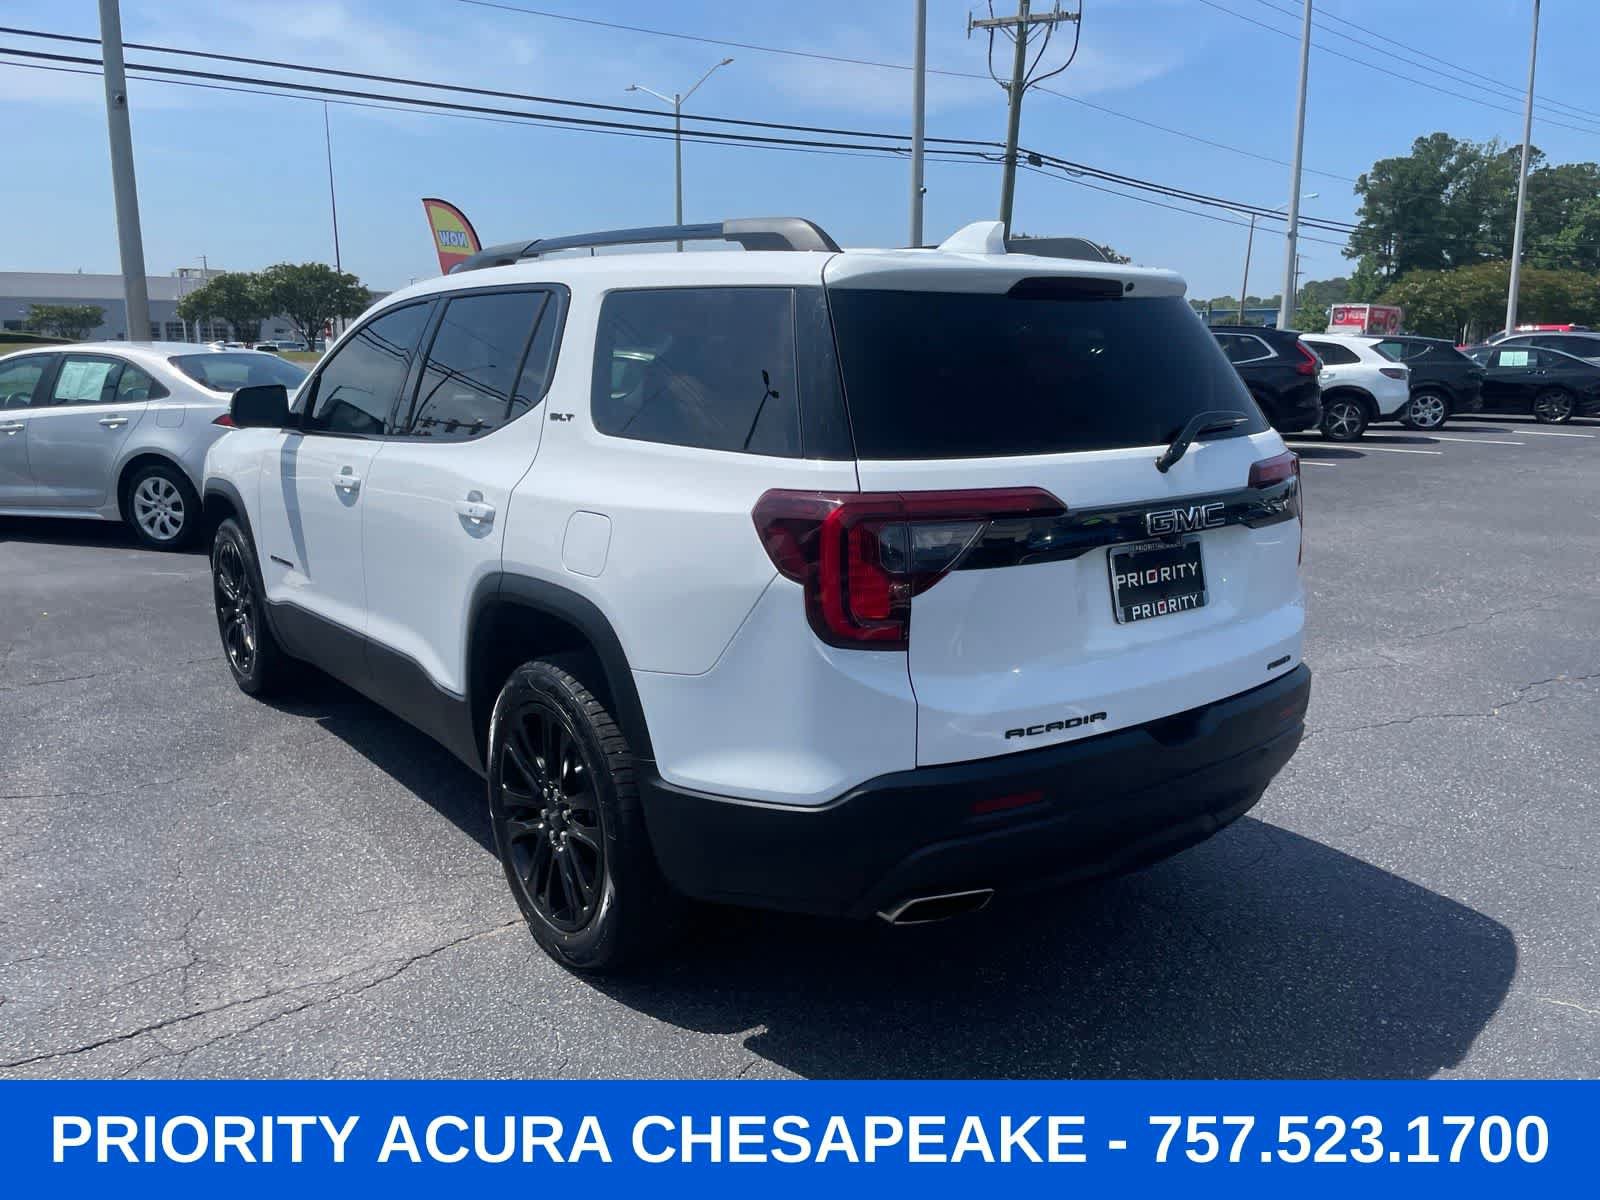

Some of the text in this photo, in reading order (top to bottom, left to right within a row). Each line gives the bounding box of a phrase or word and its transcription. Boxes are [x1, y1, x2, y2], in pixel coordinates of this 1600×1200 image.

[1146, 502, 1225, 537] GMC
[1115, 561, 1198, 590] PRIORITY
[1132, 594, 1198, 620] PRIORITY
[1004, 711, 1108, 739] ACADIA
